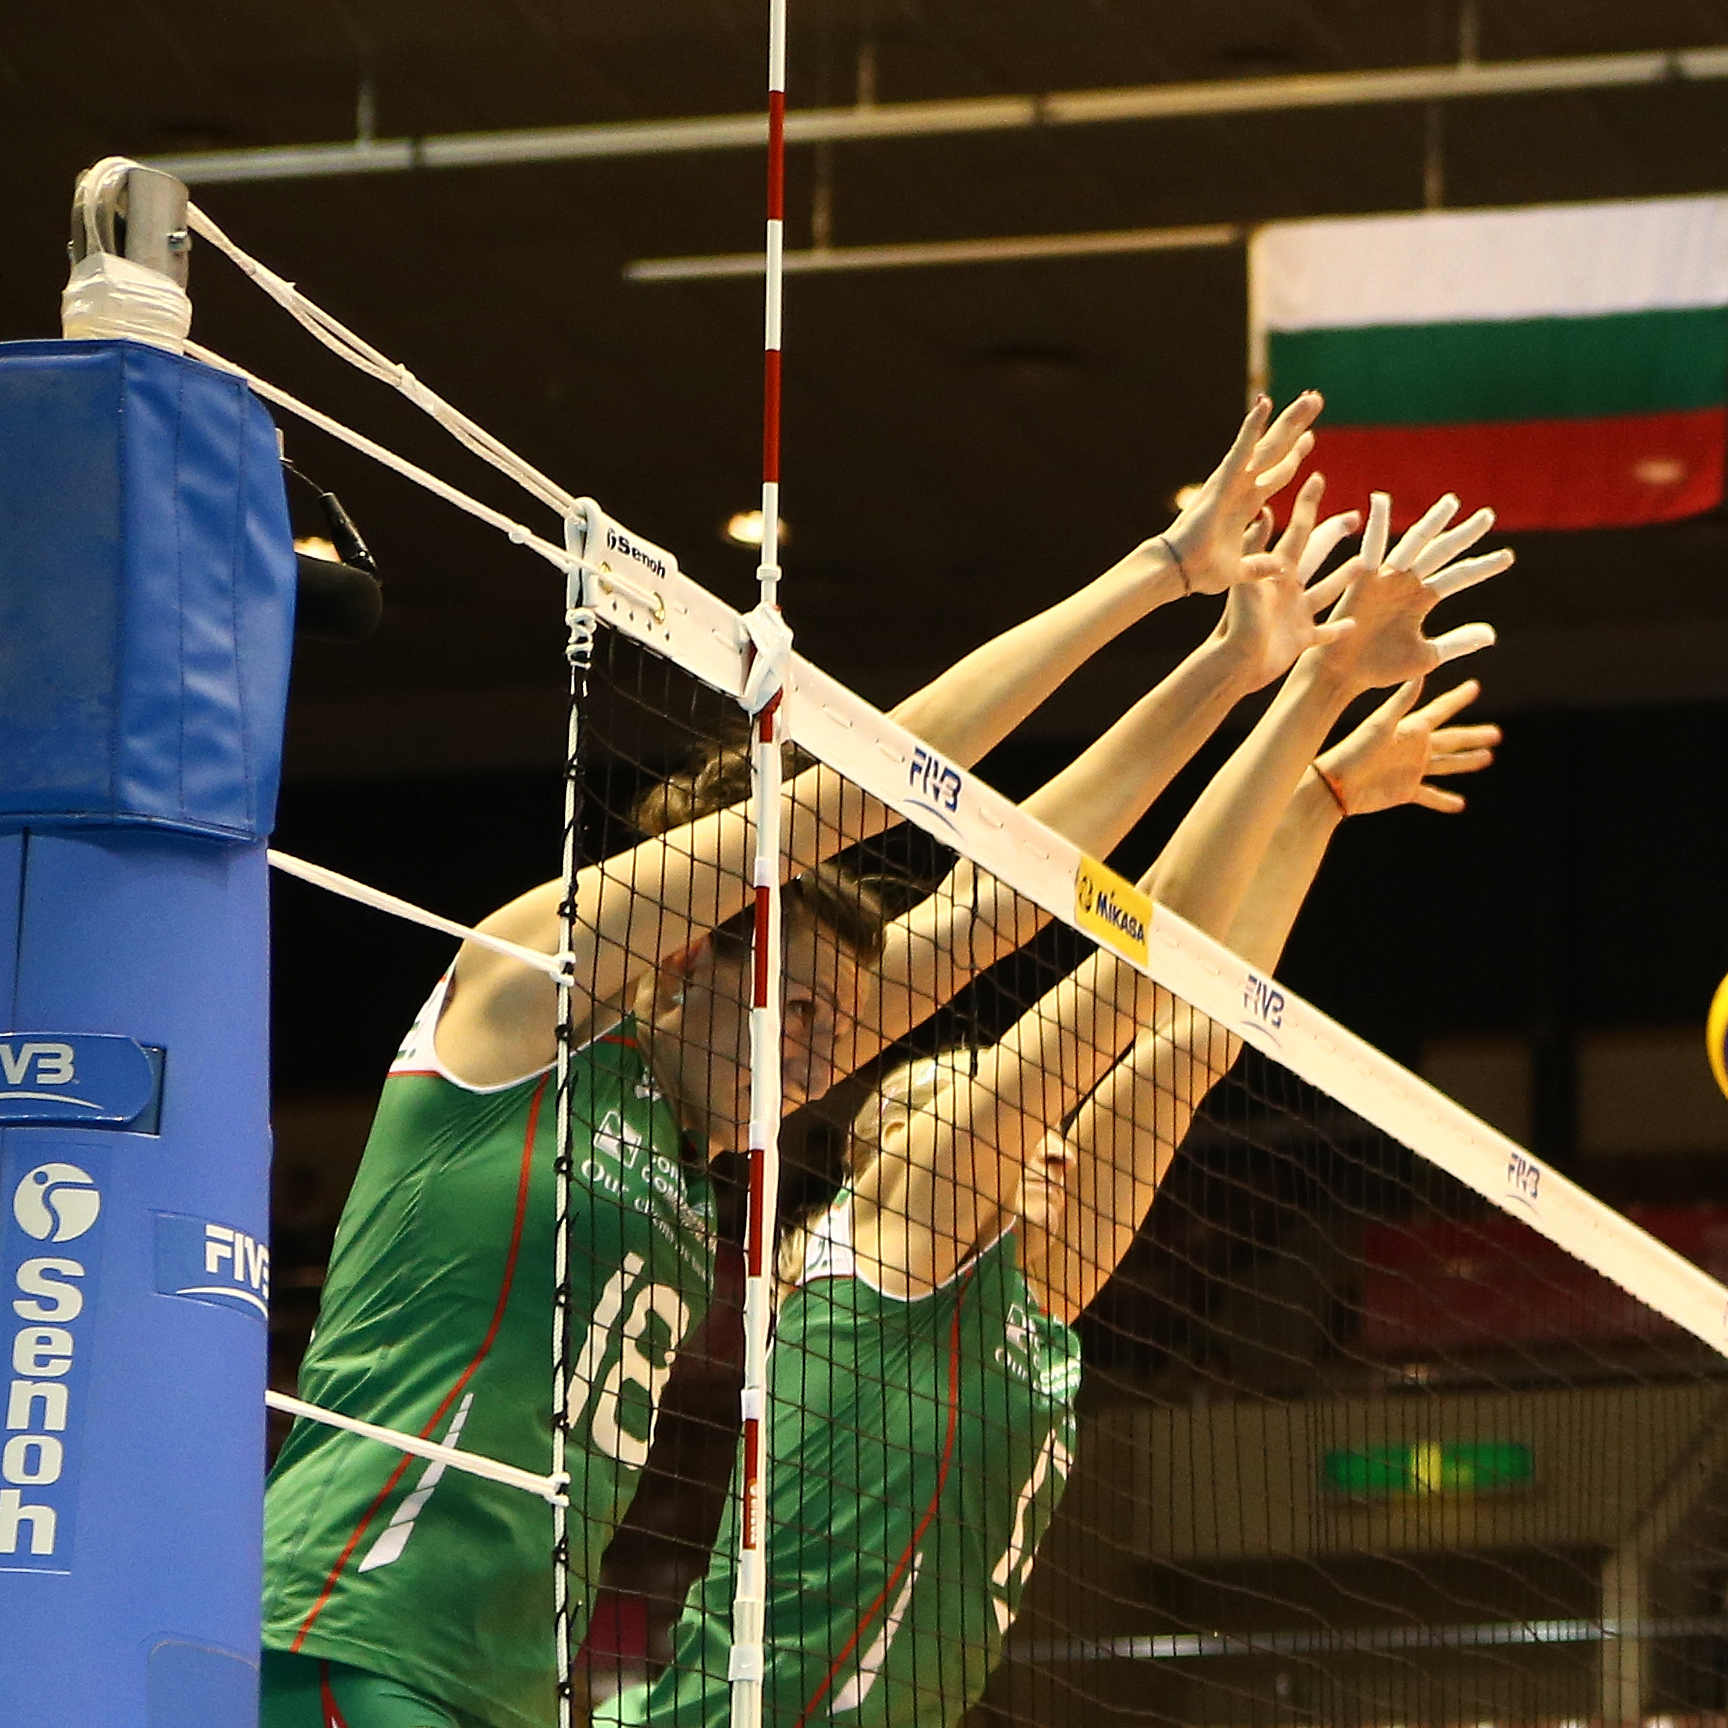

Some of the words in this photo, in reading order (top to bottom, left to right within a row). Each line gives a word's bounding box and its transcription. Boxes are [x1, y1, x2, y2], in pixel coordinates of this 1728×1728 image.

[617, 535, 667, 580] Senoh
[908, 746, 962, 813] FIVB
[1243, 973, 1285, 1030] FIVB
[1507, 1152, 1540, 1200] FIVB
[565, 1251, 691, 1471] 18
[0, 1256, 87, 1556] Senoh
